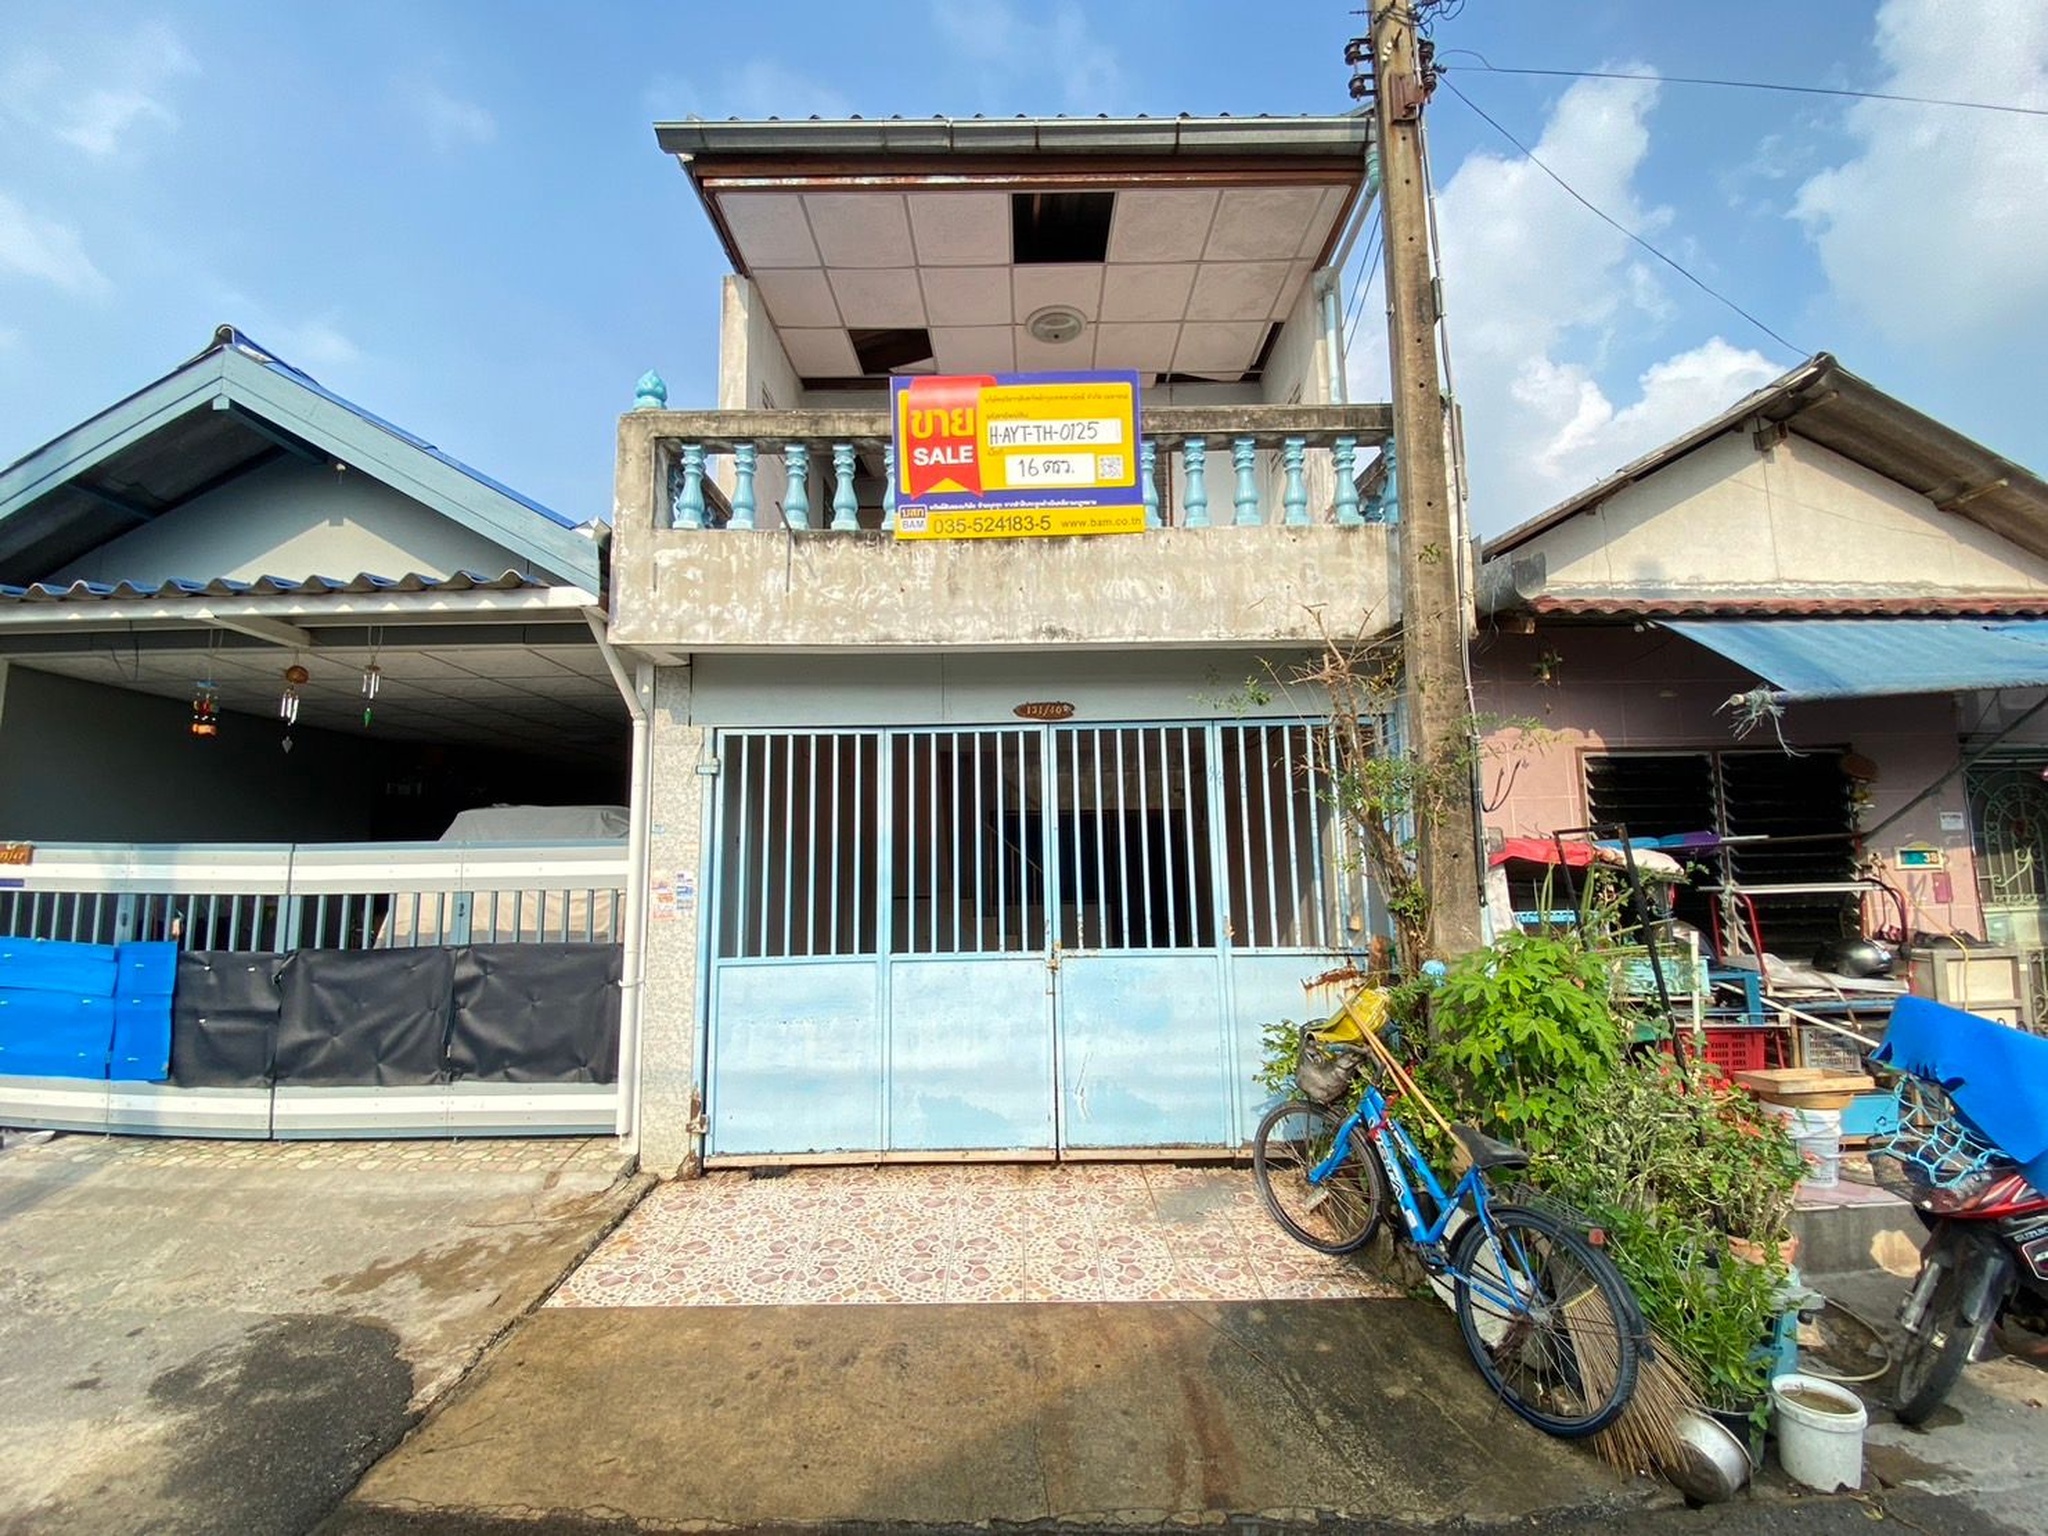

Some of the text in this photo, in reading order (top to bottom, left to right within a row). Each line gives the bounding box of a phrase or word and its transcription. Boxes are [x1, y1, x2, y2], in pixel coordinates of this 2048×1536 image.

[911, 406, 975, 439] ขาย
[913, 444, 974, 467] SALE
[1018, 458, 1039, 477] 16
[934, 515, 1051, 534] 035-524183-5
[1061, 517, 1142, 528] www.bam.co.th
